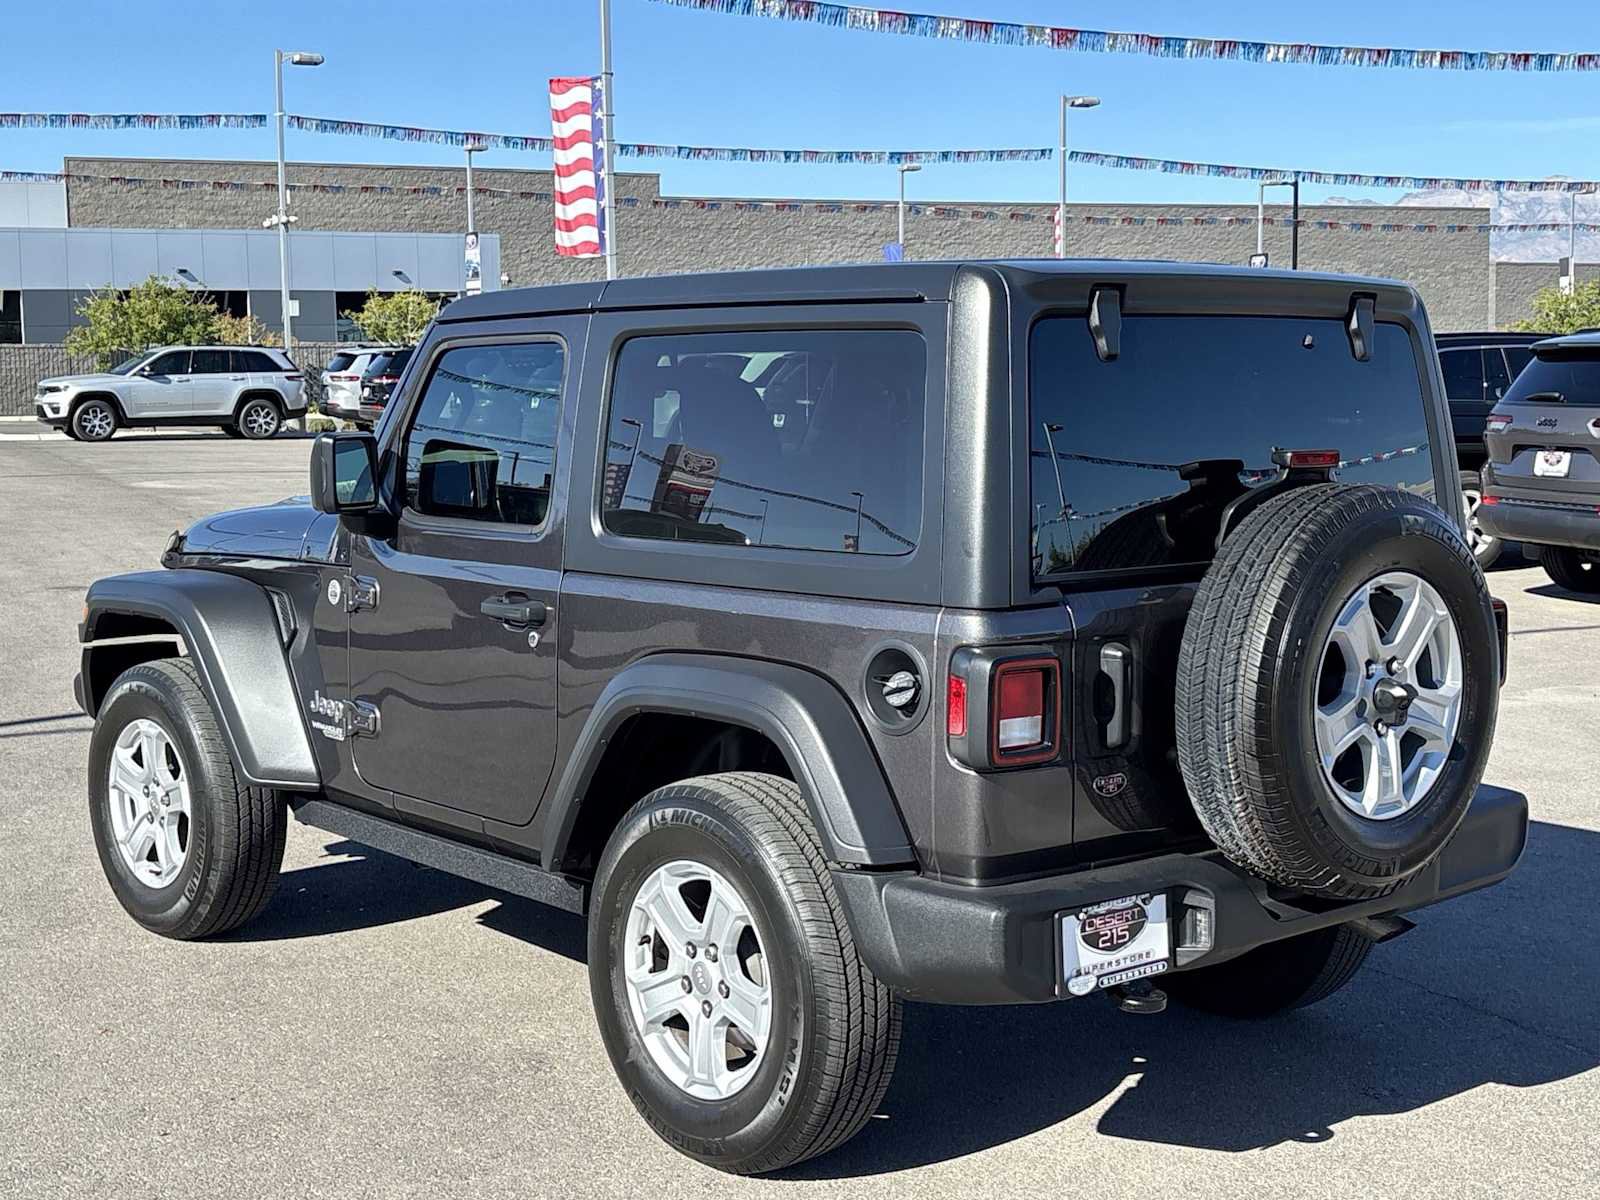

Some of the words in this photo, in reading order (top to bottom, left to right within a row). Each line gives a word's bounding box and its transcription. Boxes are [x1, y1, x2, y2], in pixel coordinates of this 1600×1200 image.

[309, 690, 344, 723] Jeep
[1085, 907, 1141, 932] DESERT
[1098, 925, 1130, 949] 215
[1072, 950, 1153, 977] SUPERSTORE
